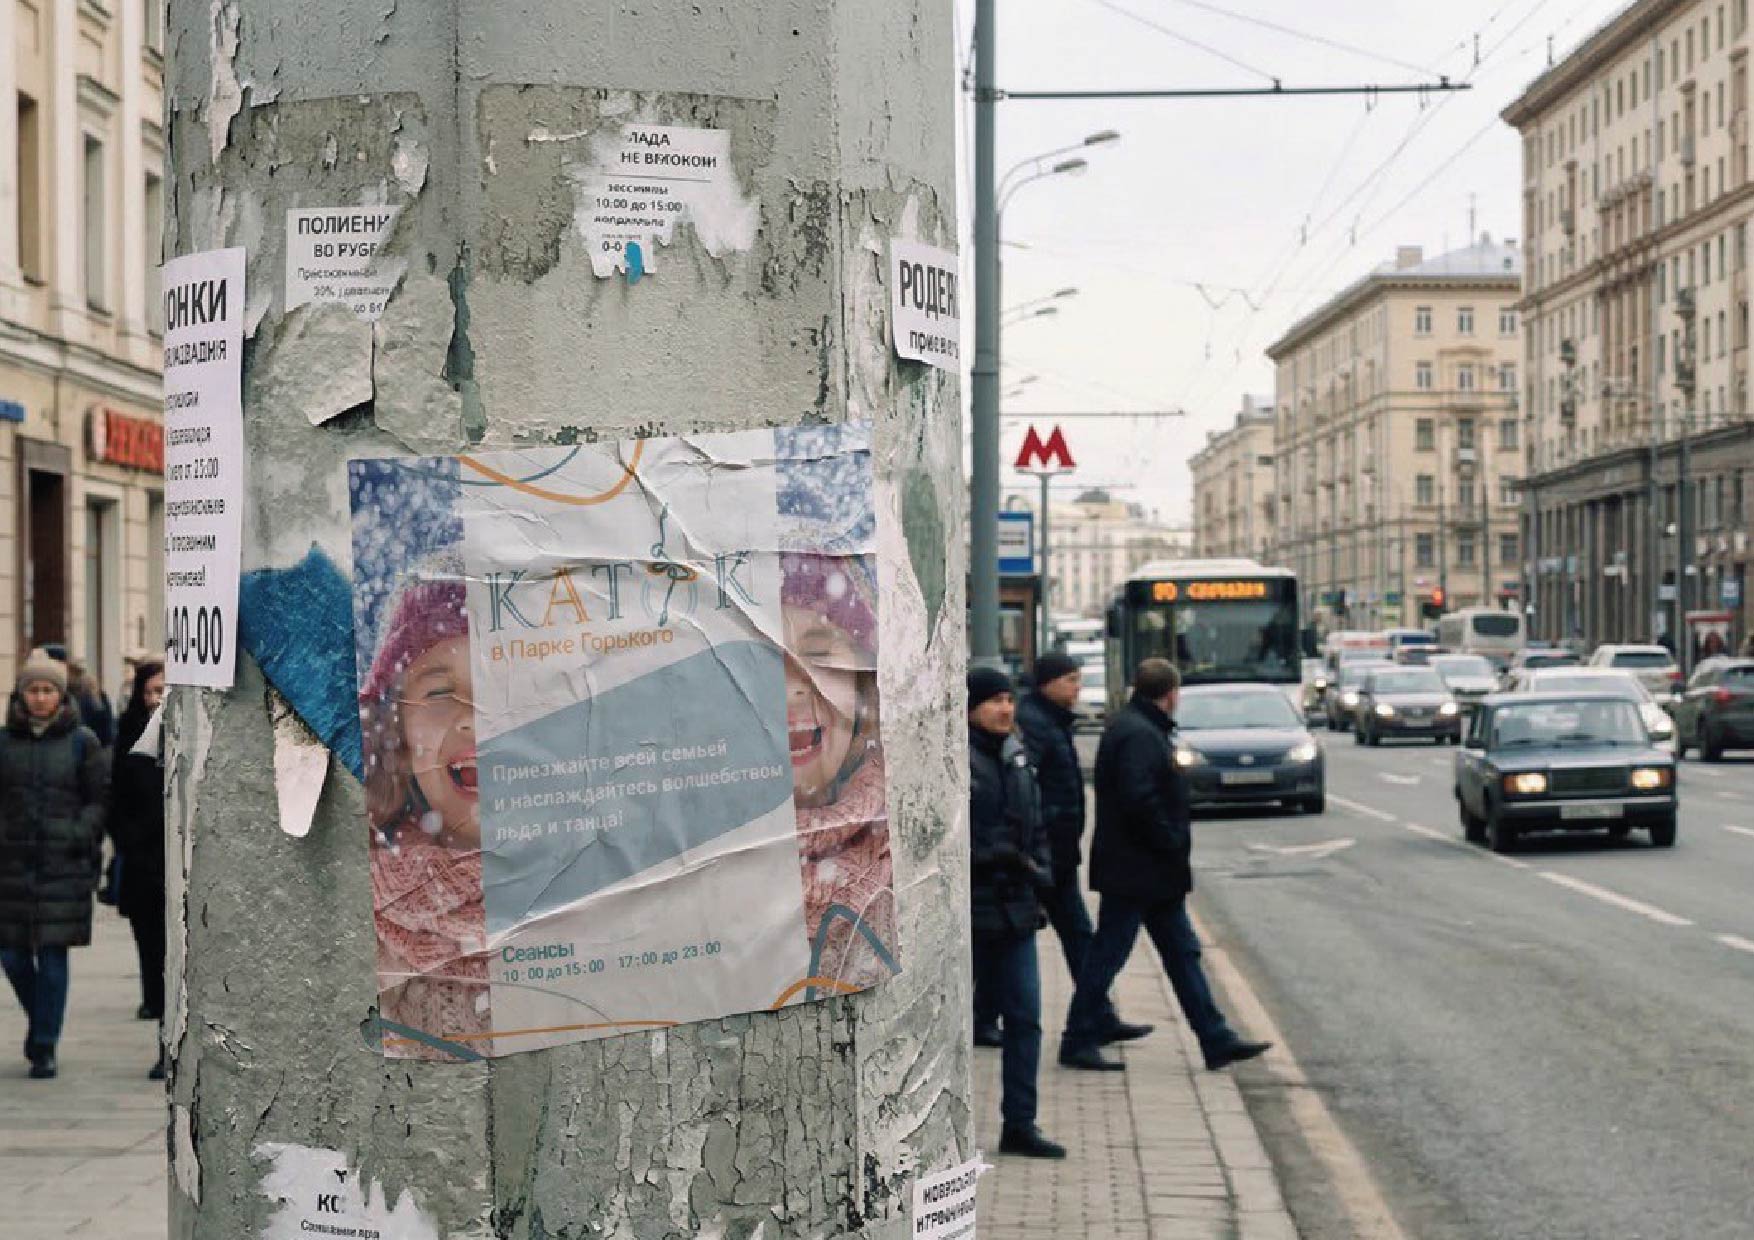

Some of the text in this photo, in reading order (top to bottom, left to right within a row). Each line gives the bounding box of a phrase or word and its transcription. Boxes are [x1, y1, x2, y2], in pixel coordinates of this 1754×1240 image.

[621, 152, 640, 164] НЕ
[595, 198, 683, 212] 10:00 до 15:00
[164, 279, 227, 331] ОНКИ
[1014, 424, 1077, 467] М
[485, 550, 761, 632] КАТОК
[490, 628, 674, 661] в Парке Горького
[492, 738, 728, 784] Приезжайте всей семьей
[493, 763, 784, 811] и наслаждайтесь волшебством
[496, 809, 624, 842] льда и танца!
[501, 942, 575, 963] Сеансы
[546, 966, 562, 981] до
[564, 959, 605, 976] 15:00
[618, 951, 658, 969] 17:00
[661, 950, 678, 965] до
[682, 940, 721, 960] 23:00
